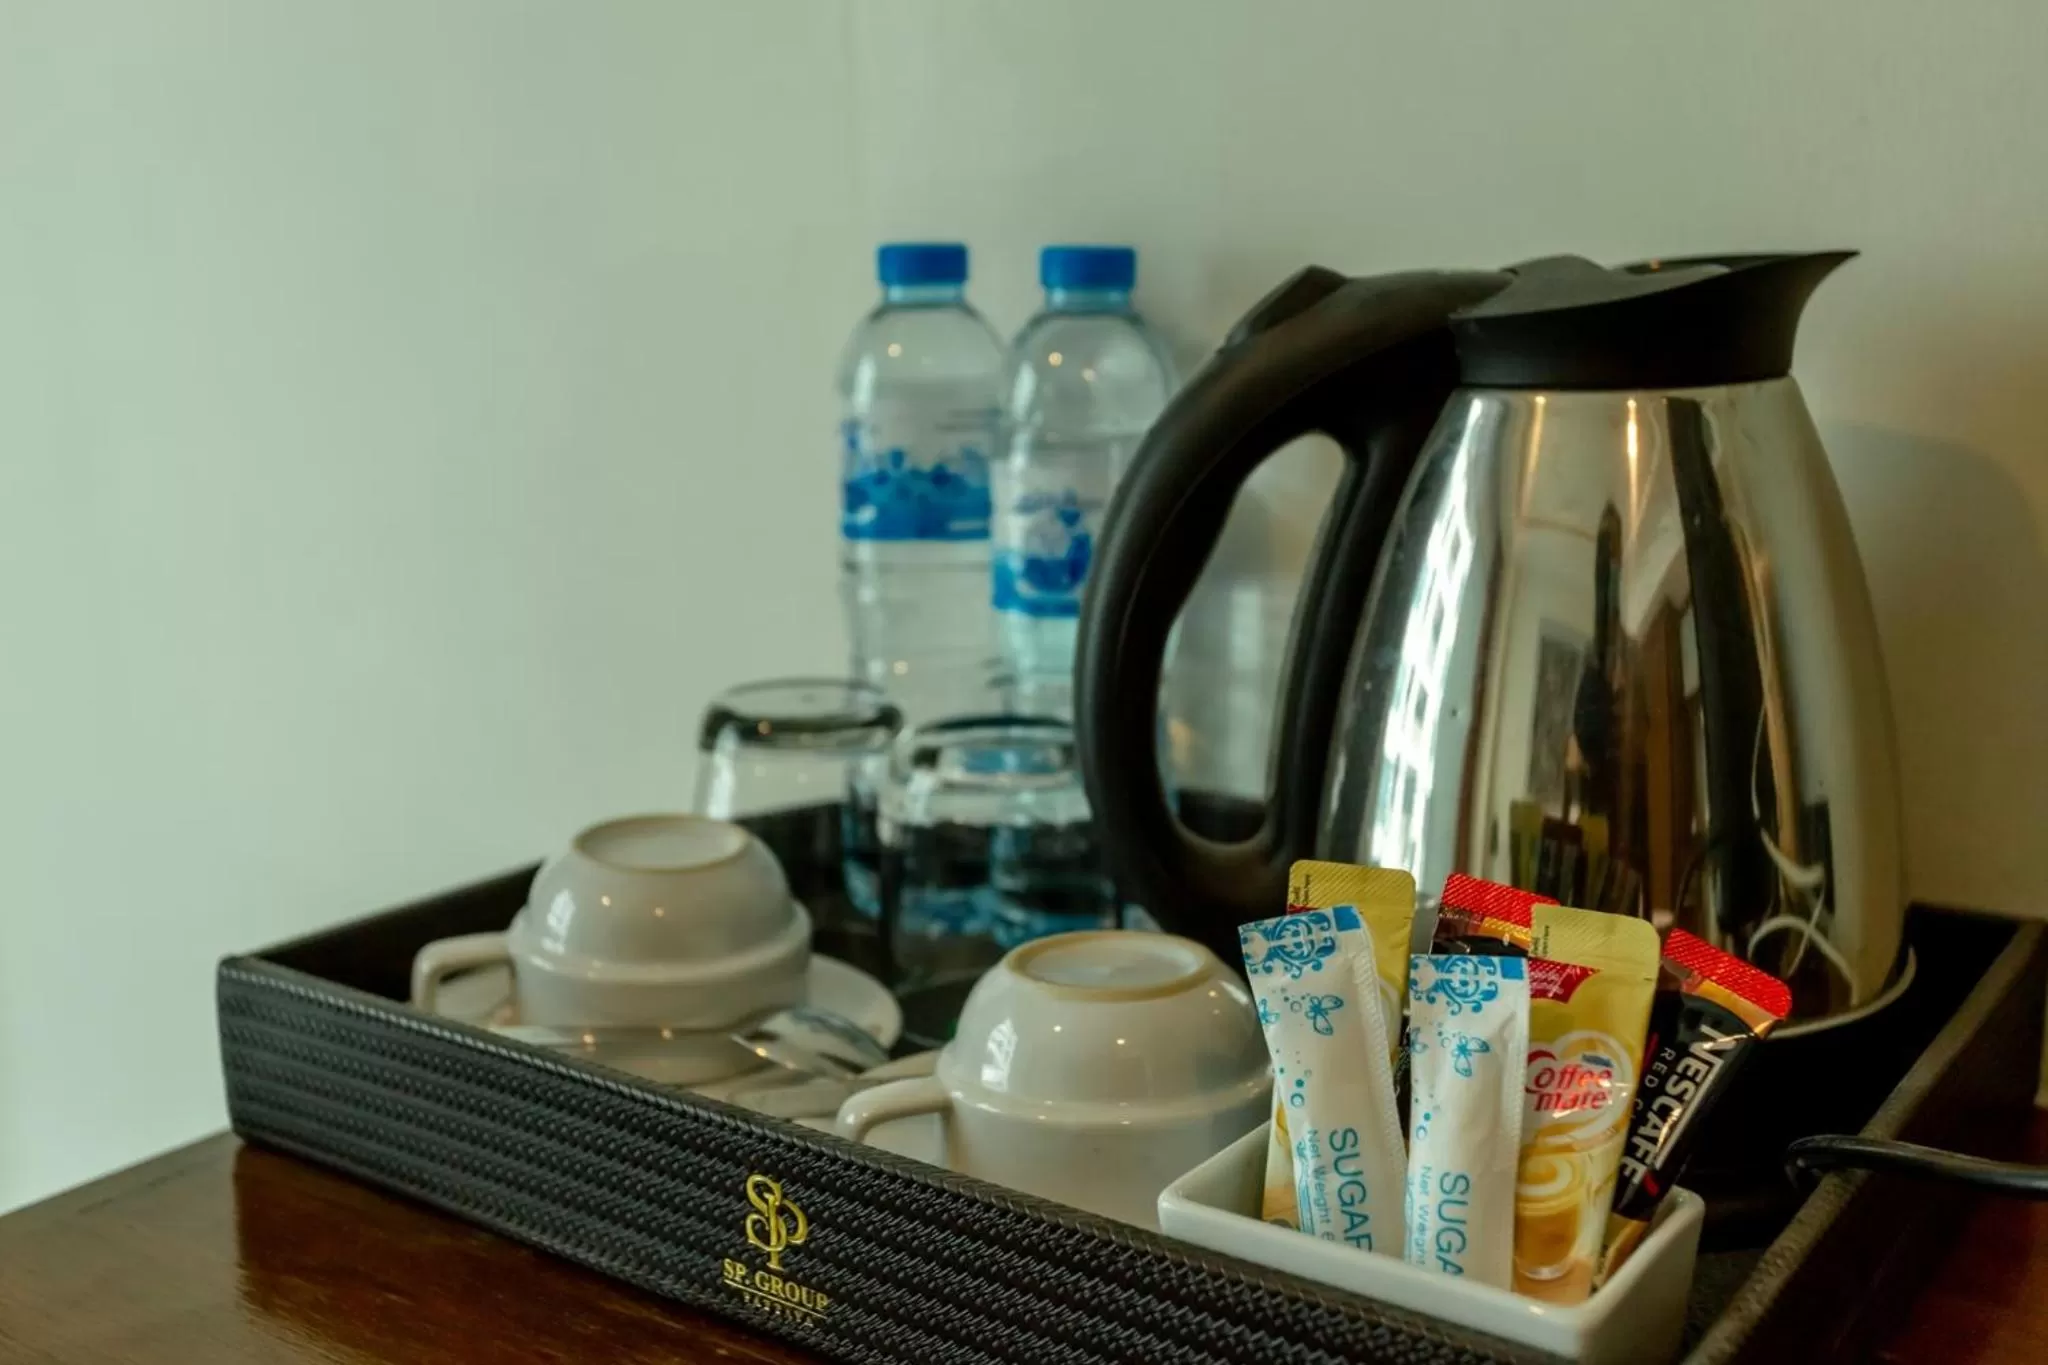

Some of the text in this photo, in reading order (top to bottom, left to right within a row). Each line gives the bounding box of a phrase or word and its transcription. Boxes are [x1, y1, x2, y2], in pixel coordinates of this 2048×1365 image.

[1644, 1047, 1676, 1089] RED
[1533, 1088, 1607, 1112] mate
[1308, 1129, 1321, 1159] Net
[1313, 1165, 1331, 1224] Weight
[1414, 1165, 1433, 1265] Net Weight
[1435, 1171, 1471, 1276] SUGA
[754, 1270, 829, 1311] GROUP
